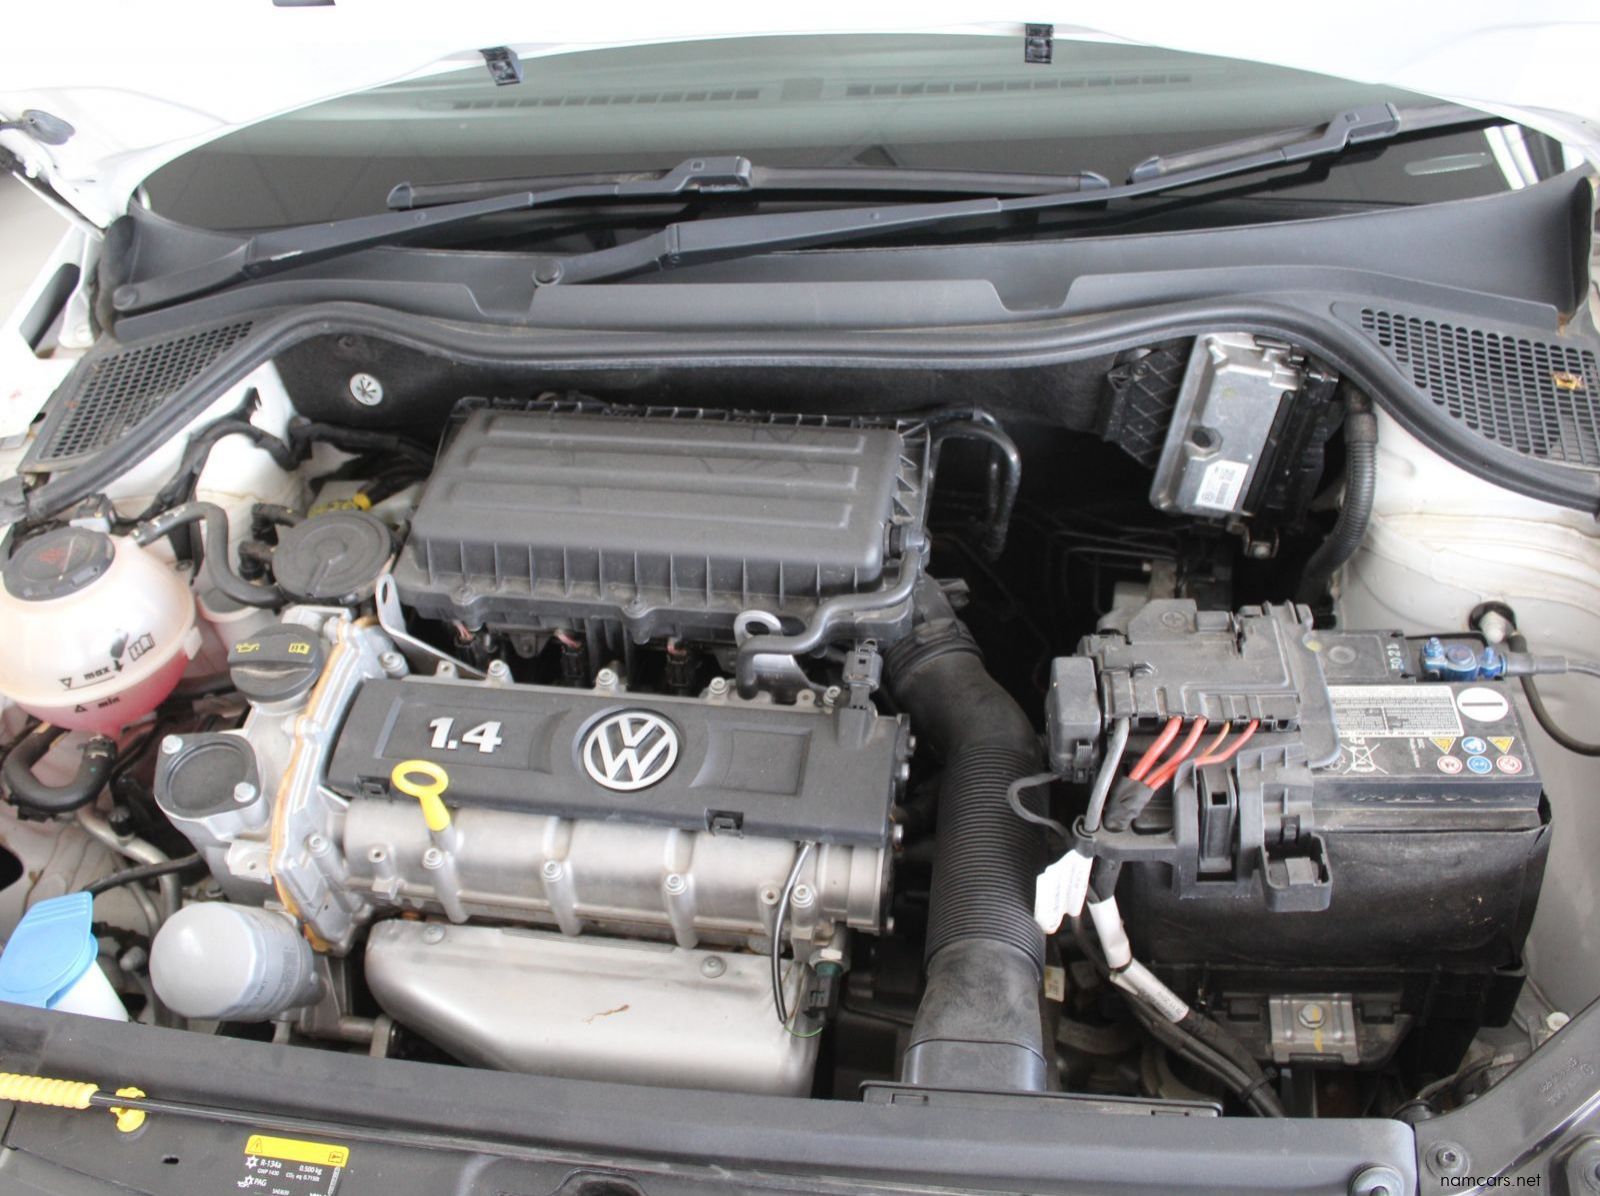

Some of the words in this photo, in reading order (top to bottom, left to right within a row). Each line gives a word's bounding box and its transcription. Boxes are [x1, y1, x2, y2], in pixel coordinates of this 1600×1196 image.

[83, 666, 111, 680] max
[97, 696, 120, 709] min
[429, 717, 502, 753] 1.4
[583, 711, 679, 790] VW
[260, 1159, 282, 1168] R-134a
[254, 1178, 267, 1186] PAG
